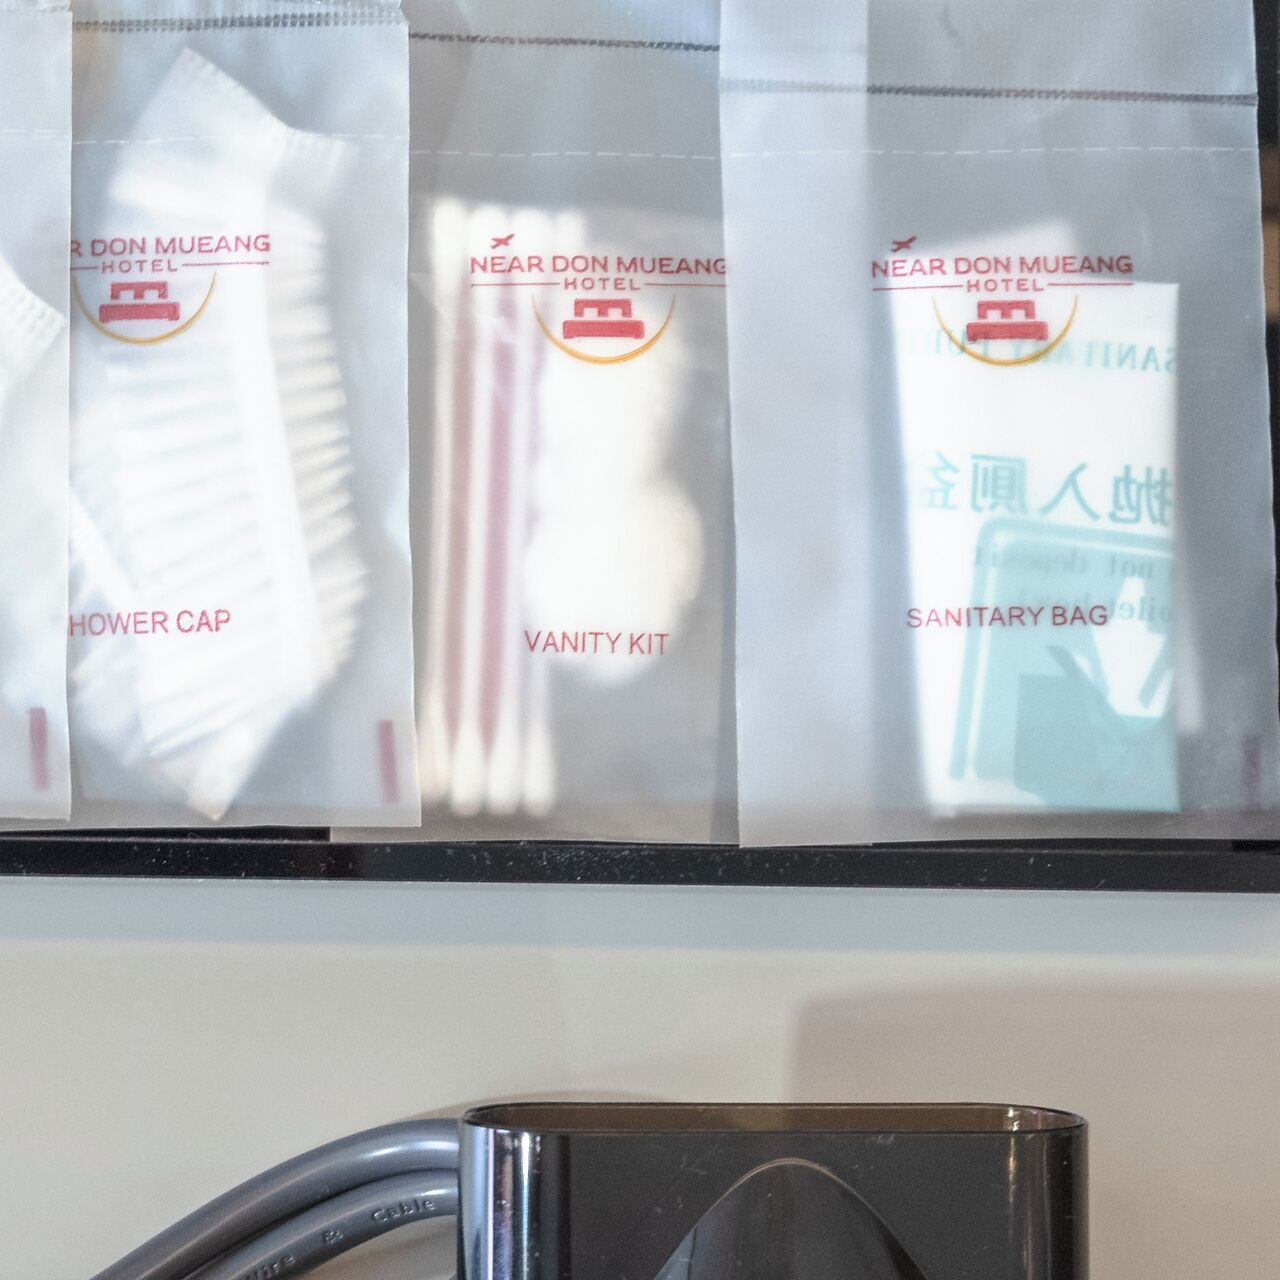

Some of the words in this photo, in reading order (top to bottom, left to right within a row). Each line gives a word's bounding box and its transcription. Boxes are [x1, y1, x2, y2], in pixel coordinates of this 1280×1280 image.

[91, 237, 147, 256] DON
[155, 234, 271, 254] MUEANG
[101, 259, 177, 273] HOTEL
[471, 256, 544, 274] NEAR
[551, 256, 608, 273] DON
[616, 256, 725, 274] MUEANG
[872, 258, 946, 277] NEAR
[955, 256, 1012, 275] DON
[1019, 255, 1132, 274] MUEANG
[563, 277, 640, 291] HOTEL
[967, 278, 1043, 292] HOTEL
[70, 610, 169, 637] HOWER
[176, 609, 231, 634] CAP
[907, 606, 1042, 628] SANITARY
[1052, 605, 1107, 628] BAG
[525, 630, 620, 654] VANITY
[629, 632, 669, 654] KIT
[370, 1195, 437, 1224] Cable
